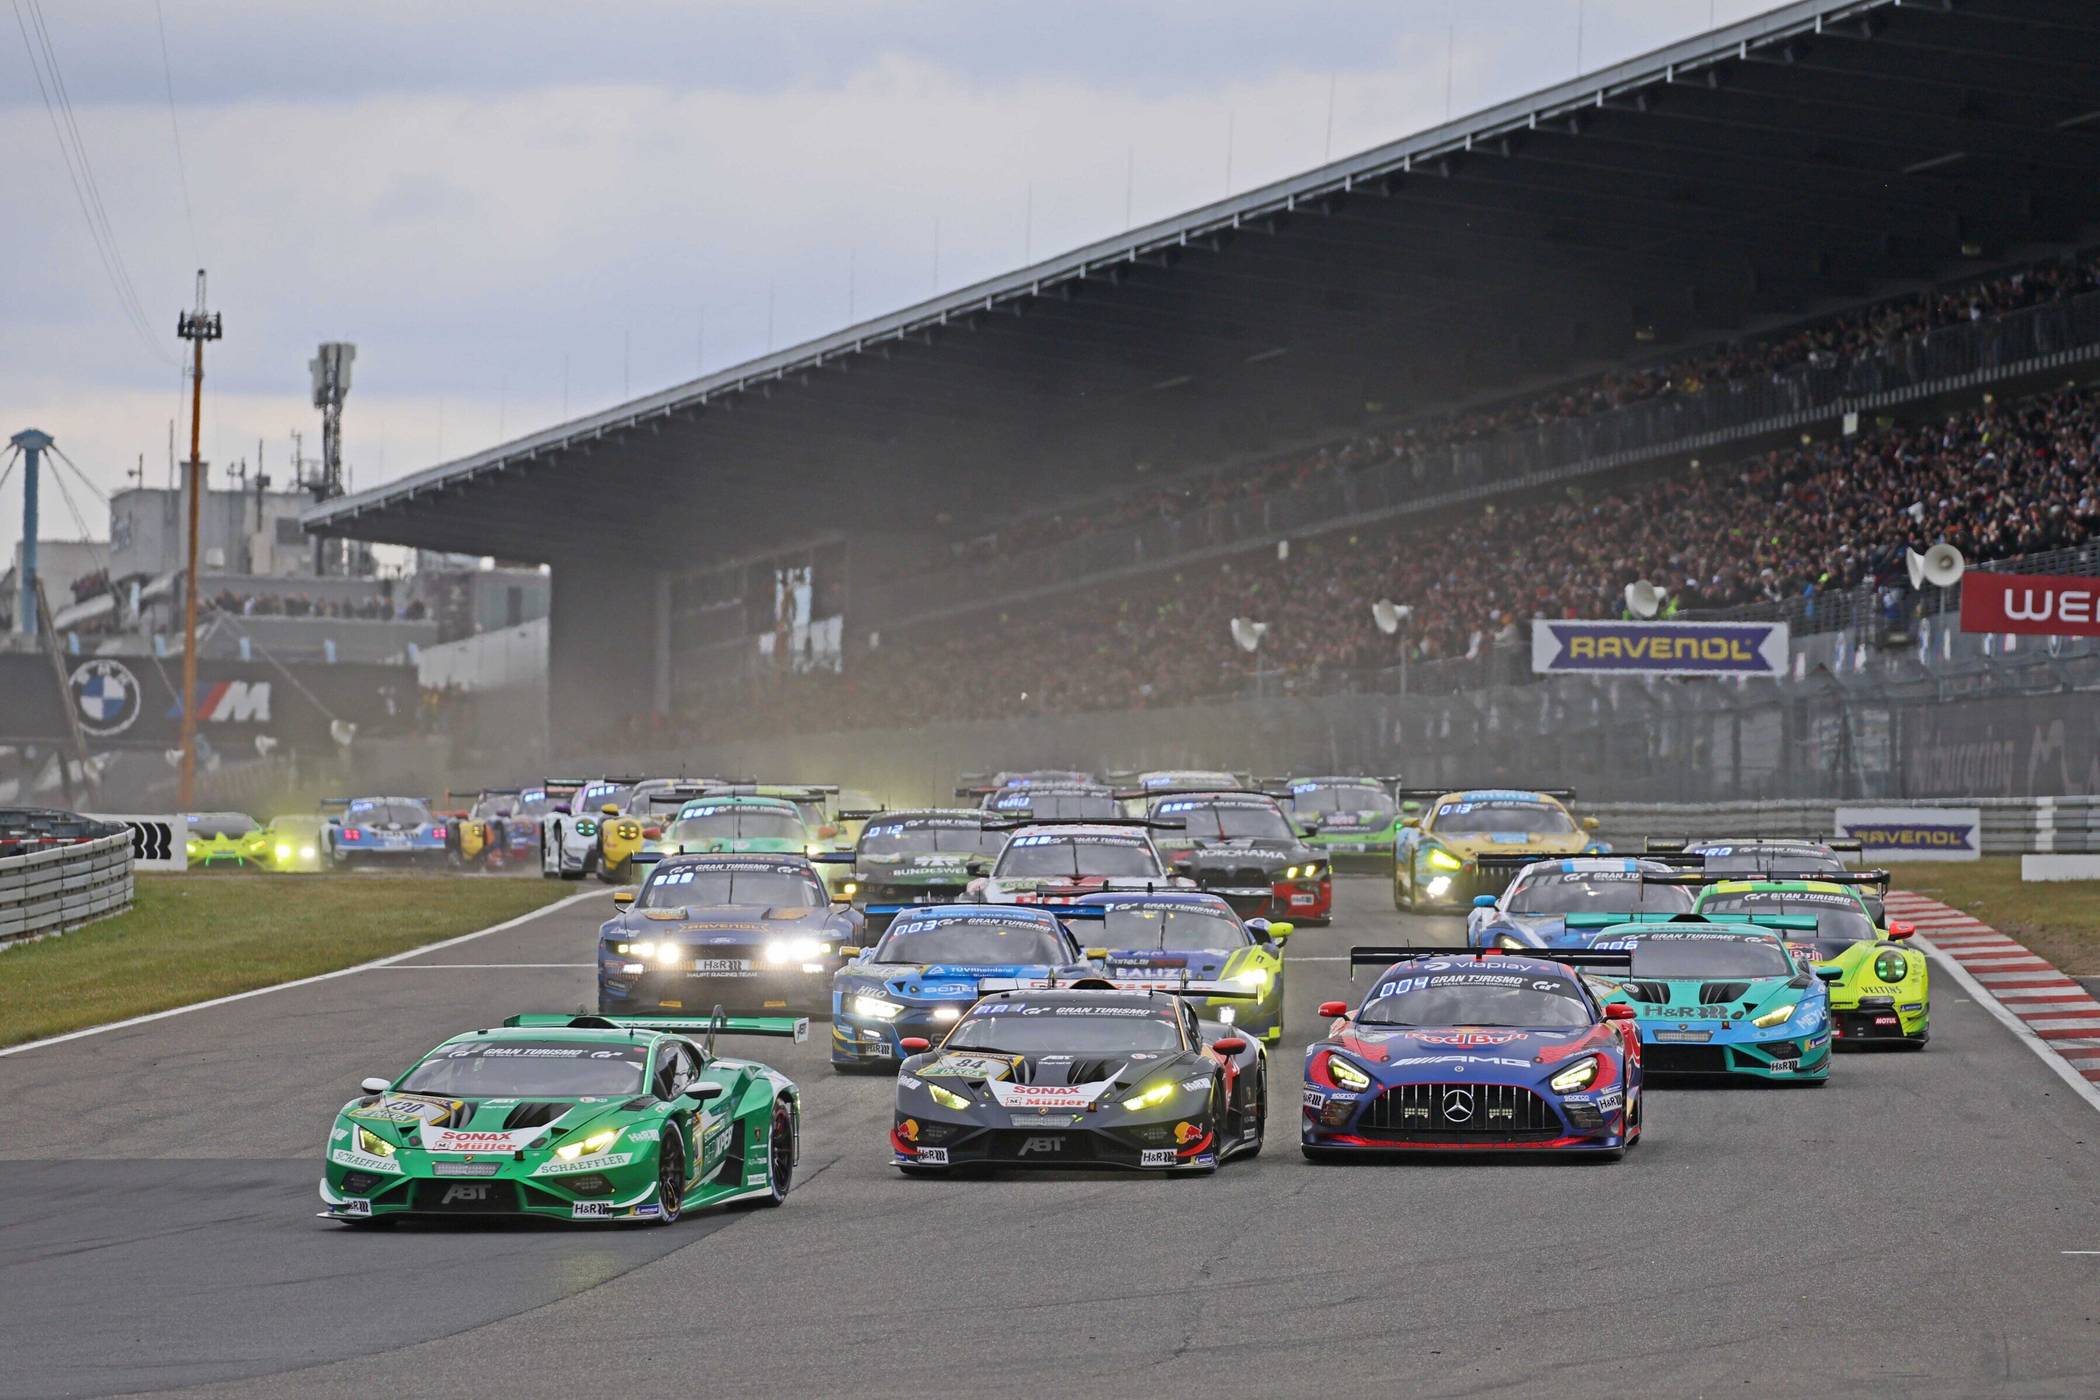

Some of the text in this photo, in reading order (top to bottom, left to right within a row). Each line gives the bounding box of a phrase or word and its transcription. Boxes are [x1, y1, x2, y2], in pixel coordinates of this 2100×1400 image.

[2004, 588, 2100, 623] WE
[1569, 635, 1753, 661] RAVENOL
[210, 680, 271, 721] M
[1854, 830, 1962, 845] RAVENOL
[1195, 849, 1287, 860] YOKOHAMA
[1803, 894, 1851, 904] TURISMO
[1685, 933, 1736, 941] TURISMO
[704, 961, 727, 970] H&R
[1455, 961, 1534, 972] viaplay
[1430, 974, 1466, 984] GRAN
[1468, 974, 1524, 984] TURISMO
[857, 985, 888, 998] HYLO
[1379, 975, 1430, 999] 004
[1860, 985, 1903, 994] VELTINS
[1056, 1007, 1094, 1015] GRAN
[1096, 1007, 1150, 1016] TURISMO
[1643, 1005, 1695, 1017] H&R
[1875, 1017, 1897, 1025] MOTUL
[483, 1048, 523, 1056] GRAN
[524, 1048, 583, 1056] TURISMO
[958, 1059, 985, 1069] 84
[1436, 1055, 1532, 1068] AMG
[1771, 1061, 1788, 1071] H&R
[1012, 1085, 1081, 1095] SONAX
[1025, 1097, 1086, 1107] Müller
[1600, 1097, 1616, 1110] H&R
[441, 1131, 512, 1141] SONAX
[454, 1141, 516, 1151] Müller
[1017, 1136, 1067, 1156] ABT
[335, 1150, 398, 1171] SCHAEFFLER
[1143, 1152, 1163, 1163] H&R
[540, 1154, 626, 1174] SCHAEFFLER
[441, 1183, 492, 1205] ABT
[574, 1202, 597, 1214] H&R
